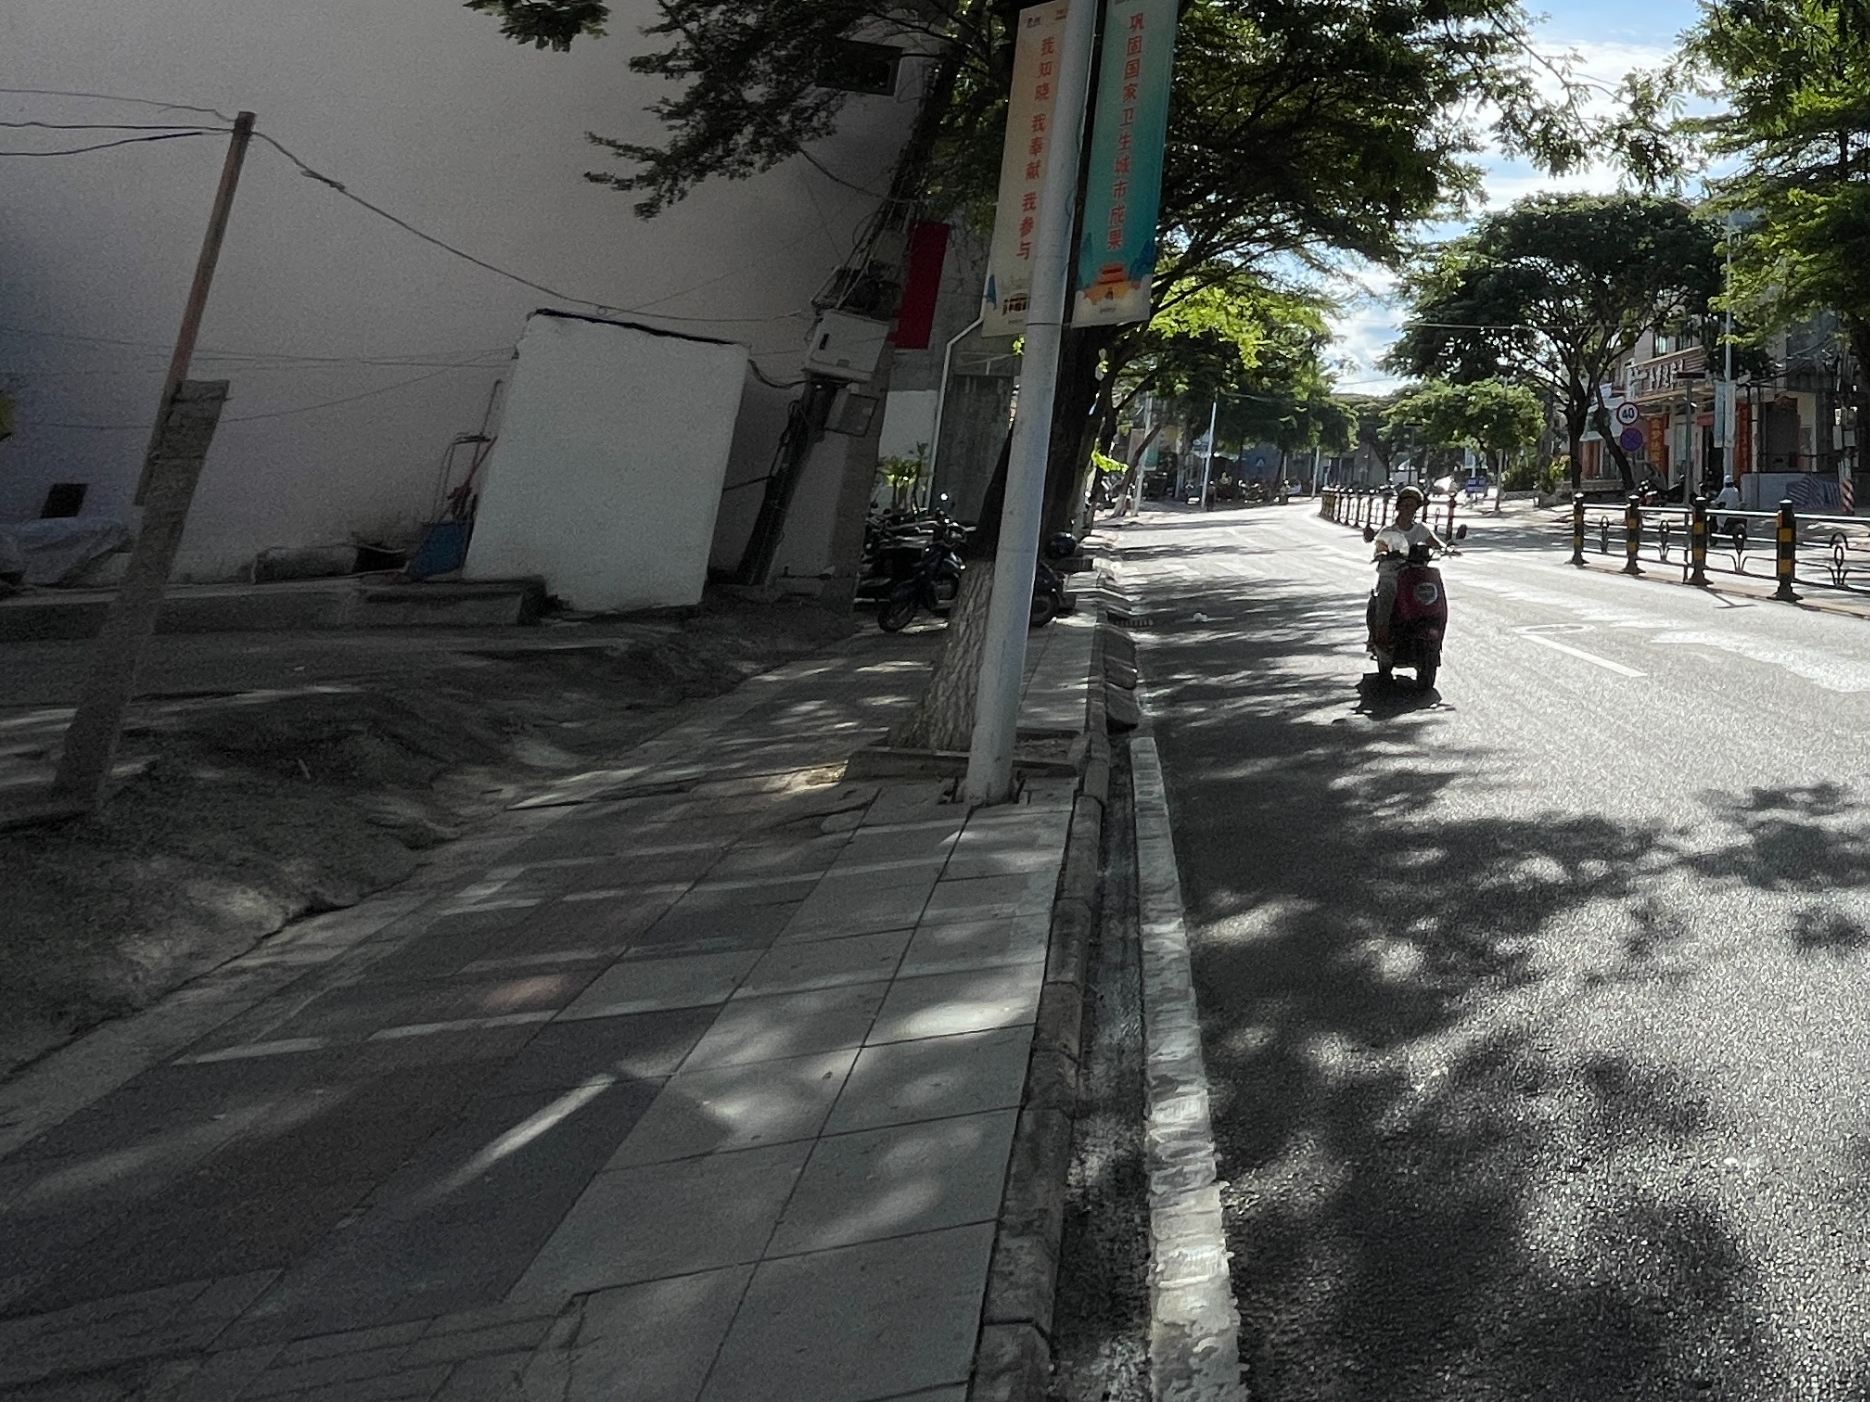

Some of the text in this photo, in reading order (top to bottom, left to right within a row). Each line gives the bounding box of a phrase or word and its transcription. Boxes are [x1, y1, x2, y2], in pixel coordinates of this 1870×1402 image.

[1016, 36, 1055, 260] 我知晓 我奉献 我参与
[1106, 12, 1144, 251] 巩固国家卫生城市成果
[1621, 407, 1635, 420] 40
